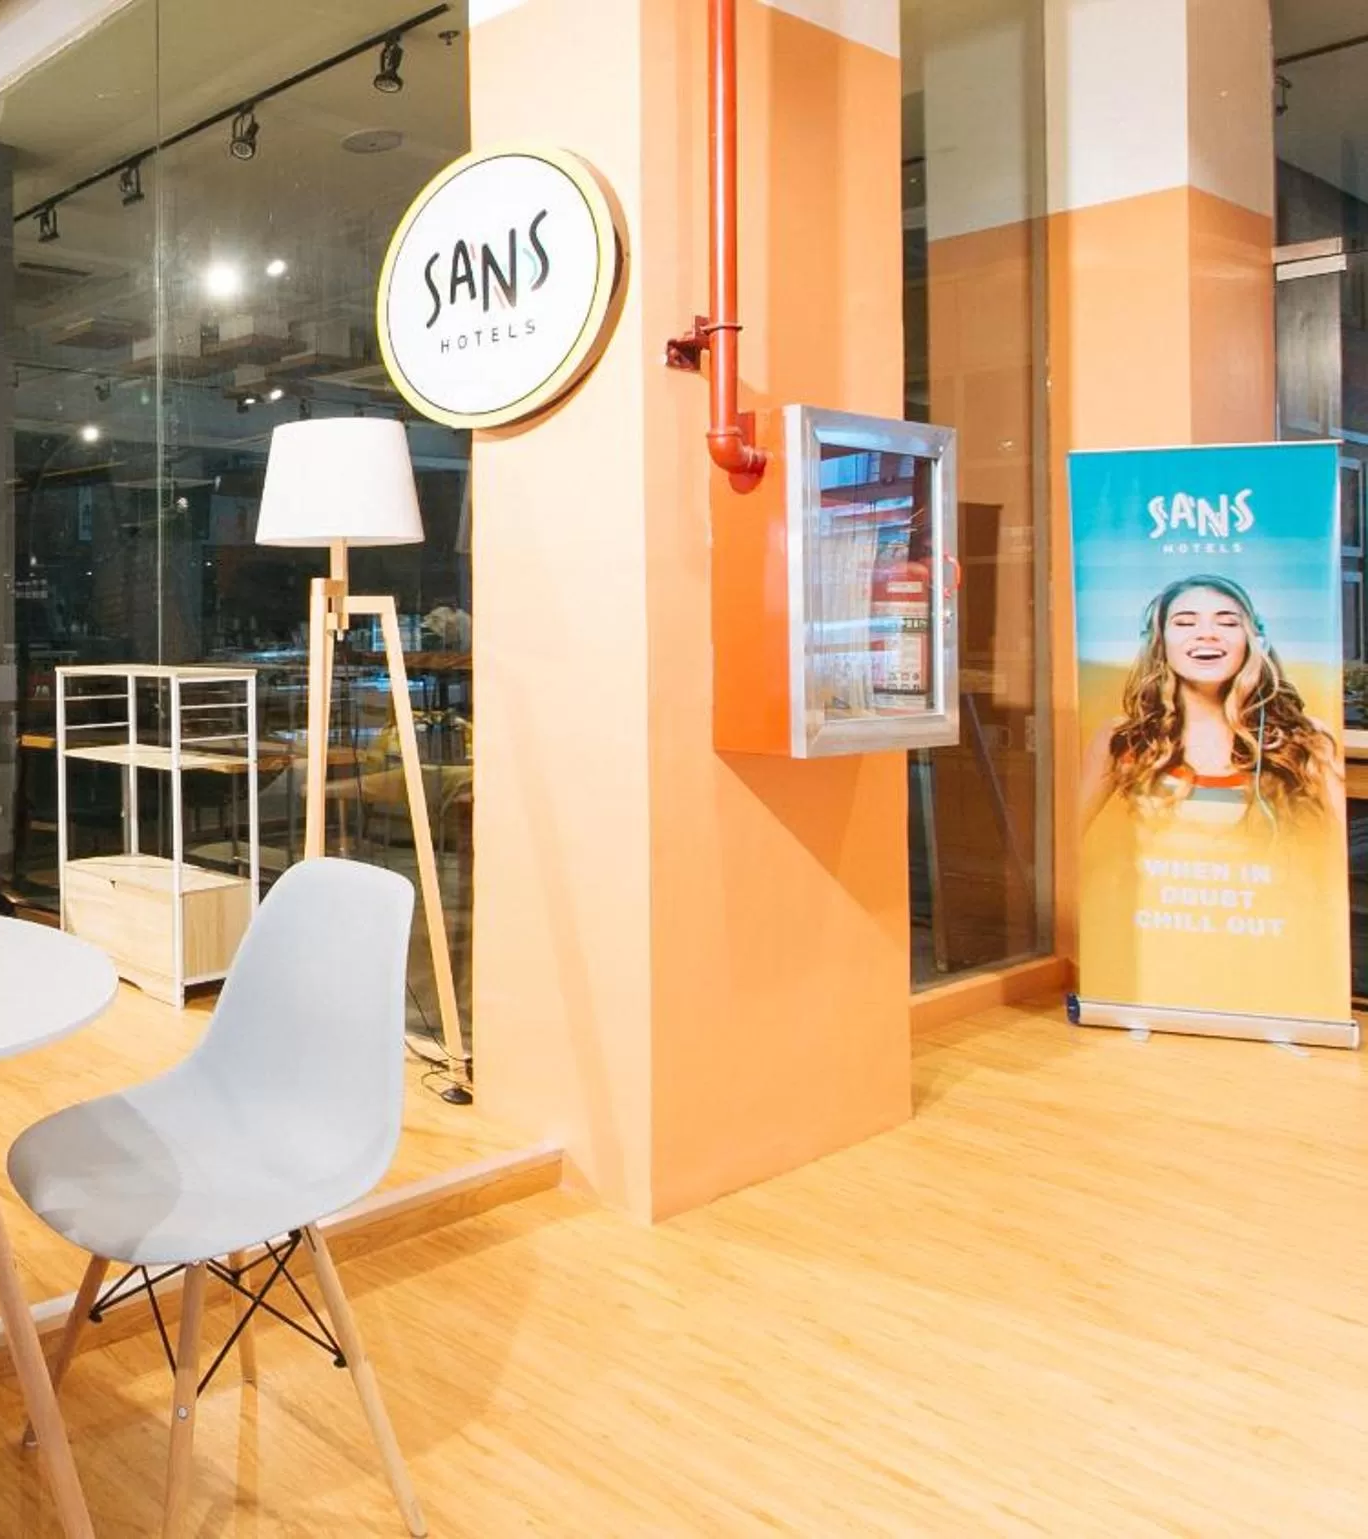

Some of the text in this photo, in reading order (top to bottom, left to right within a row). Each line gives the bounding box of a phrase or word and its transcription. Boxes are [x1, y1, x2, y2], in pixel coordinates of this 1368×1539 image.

[424, 209, 550, 329] SANS
[440, 319, 537, 354] HOTELS
[1147, 487, 1256, 539] SANS
[1162, 542, 1243, 554] HOTELS
[1142, 858, 1273, 885] WHEN IN
[1159, 885, 1256, 910] DOUBT
[1134, 909, 1287, 937] CHILL OUT
